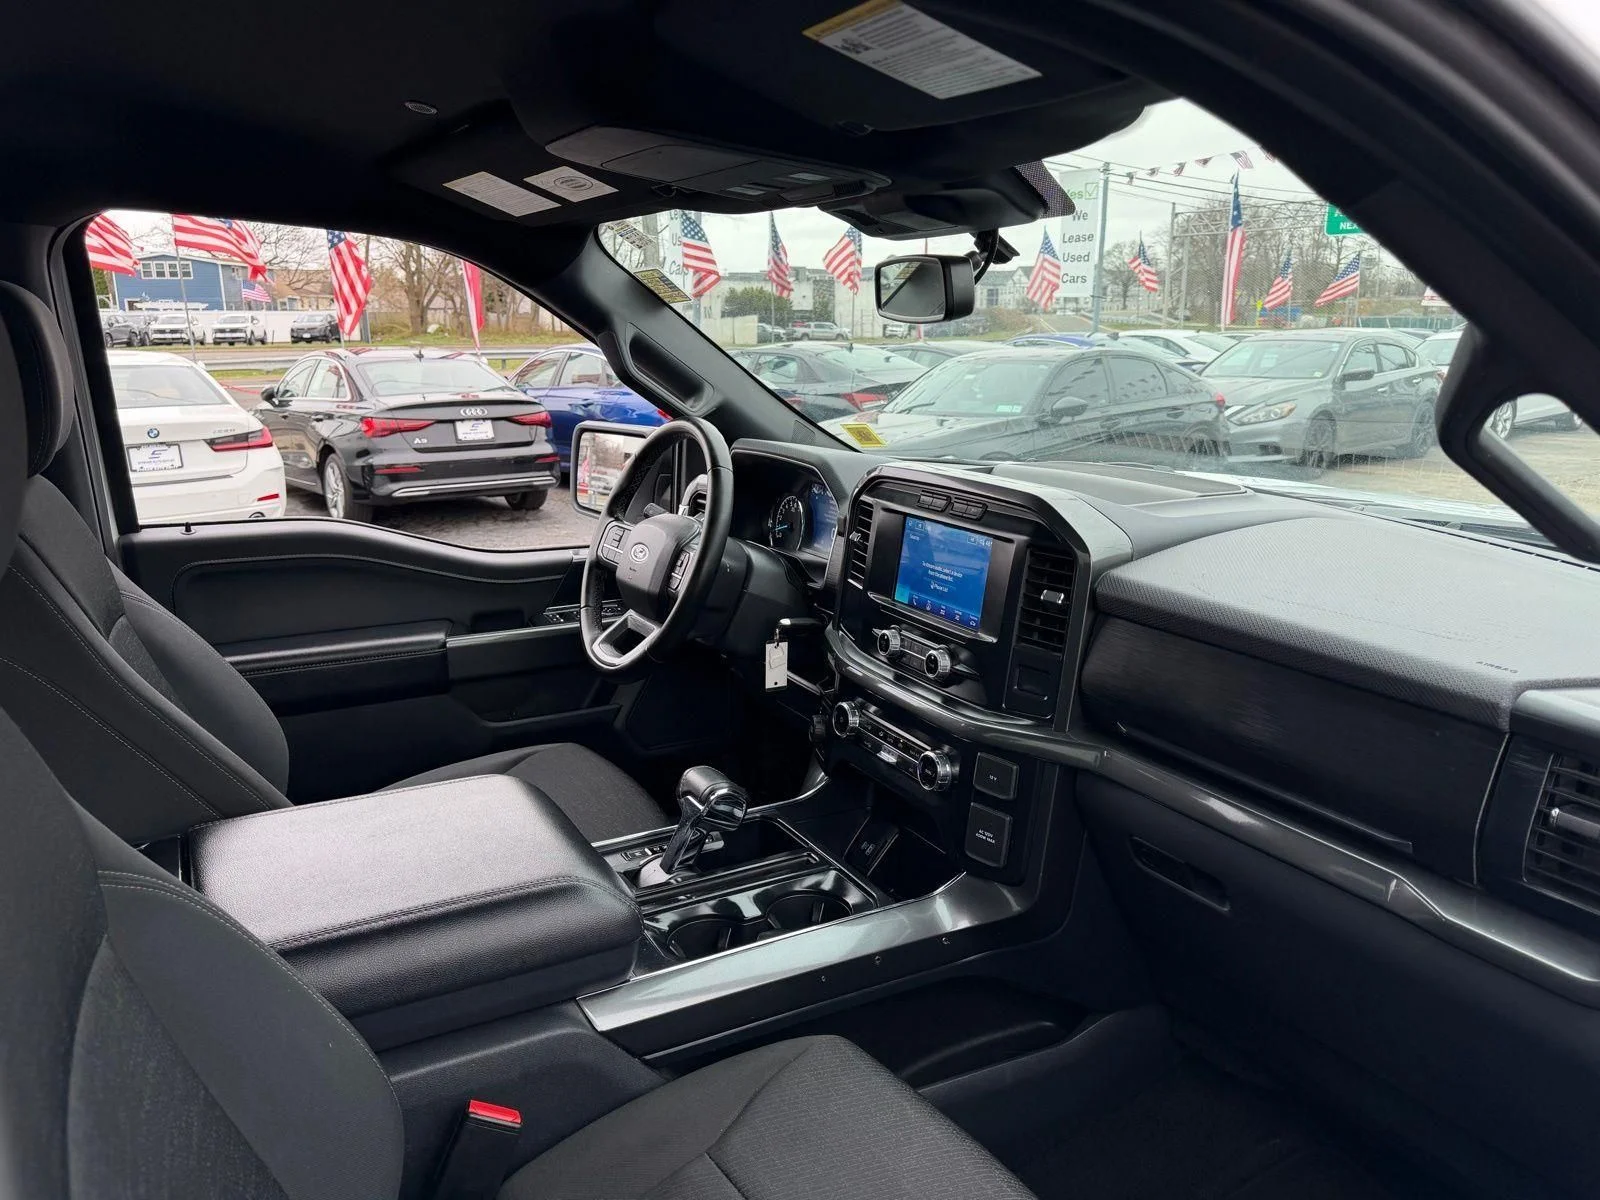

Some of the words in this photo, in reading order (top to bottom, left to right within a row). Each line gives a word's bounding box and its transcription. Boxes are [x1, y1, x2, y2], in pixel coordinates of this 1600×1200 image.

[1339, 222, 1359, 230] NEX
[1062, 233, 1094, 243] Lease
[1062, 252, 1091, 263] Used
[1061, 273, 1087, 284] Cars
[1475, 661, 1519, 673] AIRBAG
